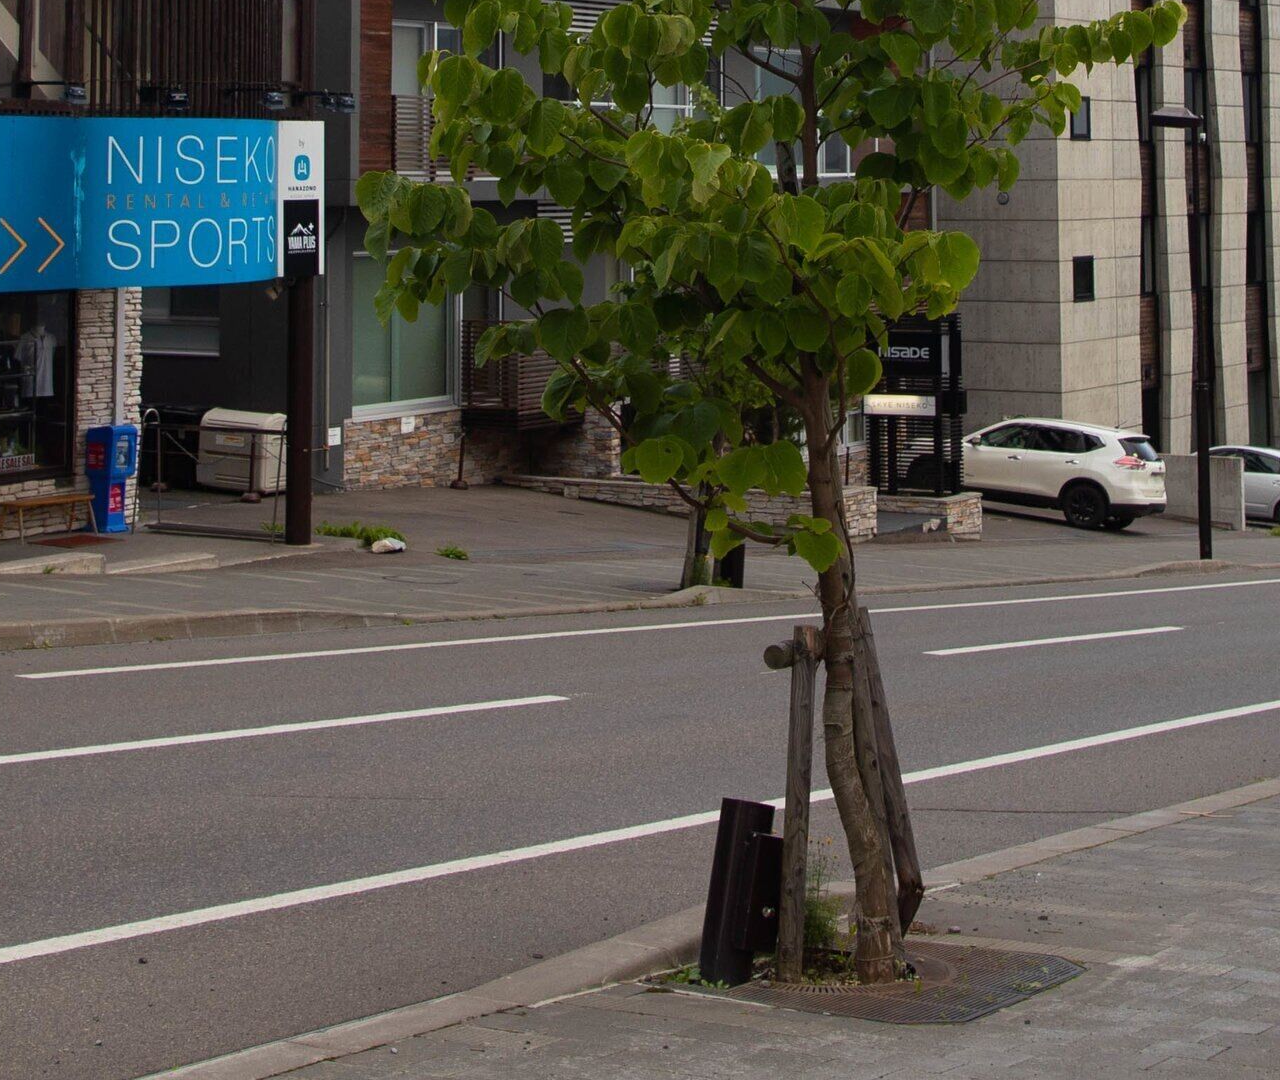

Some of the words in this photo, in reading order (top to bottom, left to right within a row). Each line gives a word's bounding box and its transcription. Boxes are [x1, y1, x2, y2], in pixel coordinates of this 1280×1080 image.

[107, 135, 276, 185] NISEKO
[106, 193, 205, 210] RENTAL
[220, 192, 230, 208] &
[106, 215, 276, 271] SPORTS
[896, 401, 928, 410] NISEKO
